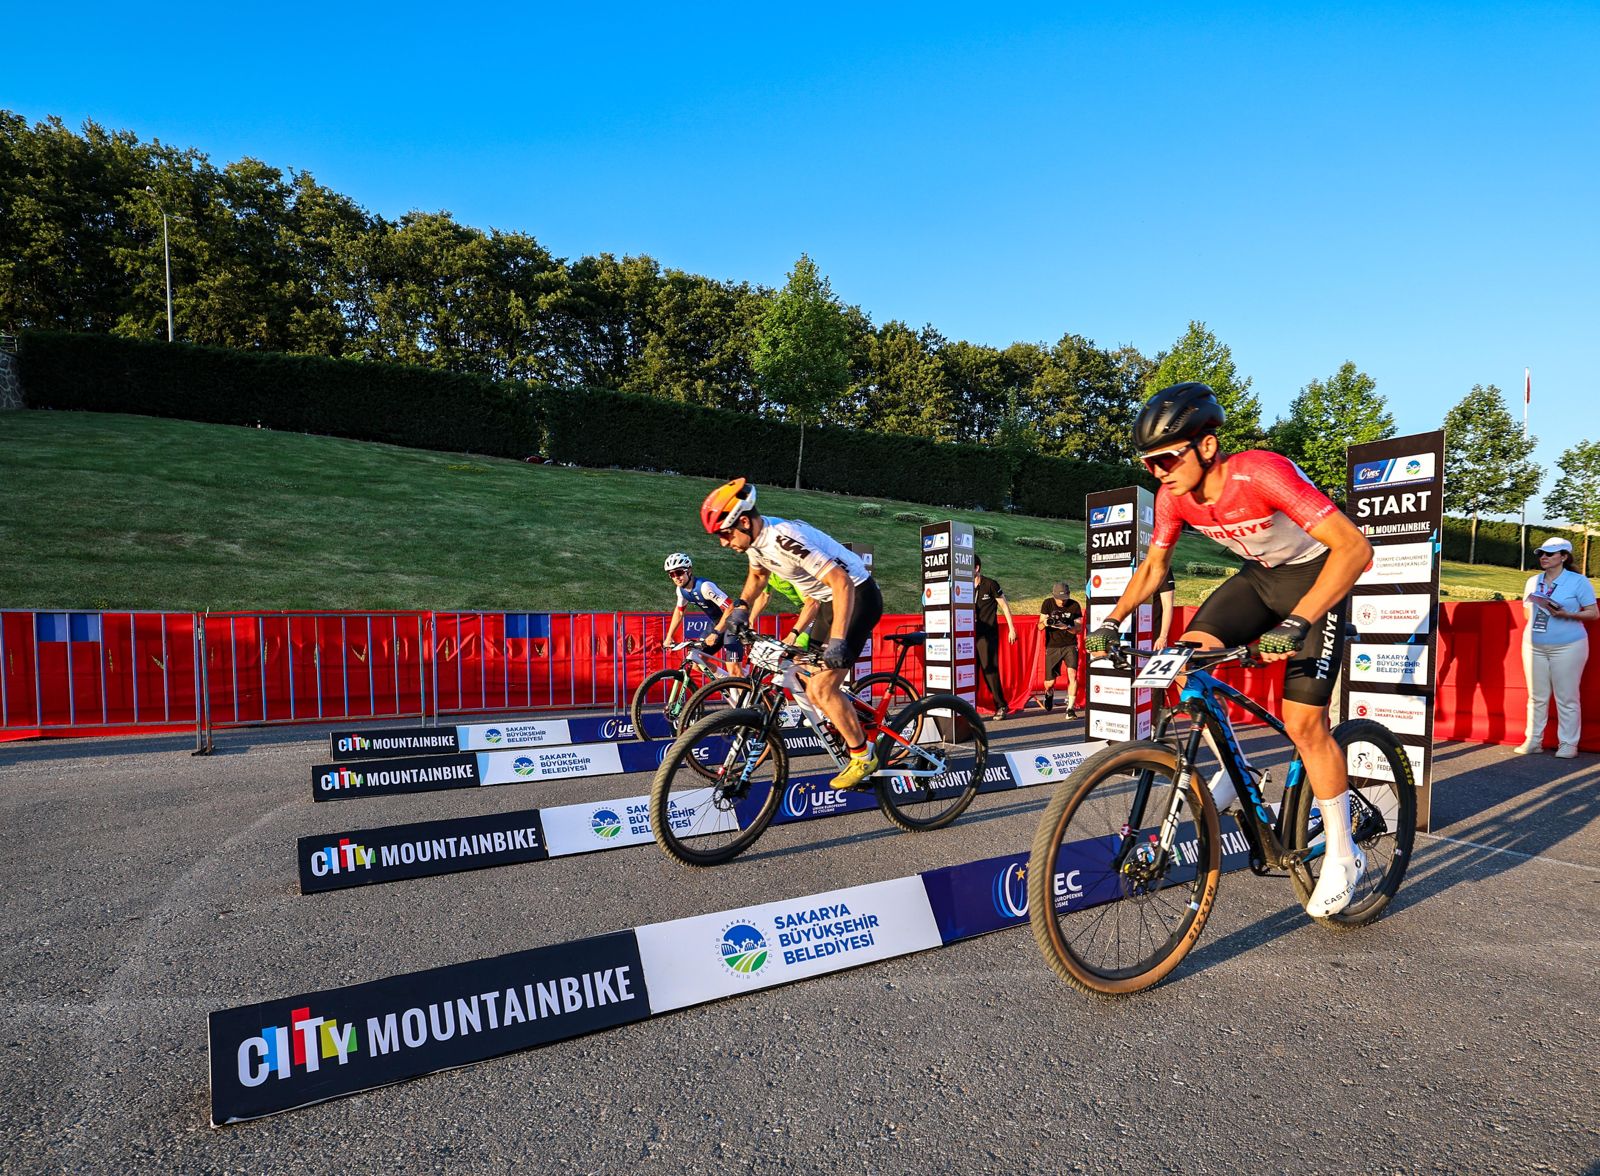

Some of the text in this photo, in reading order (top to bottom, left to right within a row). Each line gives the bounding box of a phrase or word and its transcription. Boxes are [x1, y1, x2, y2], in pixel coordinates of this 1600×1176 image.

[1356, 490, 1432, 517] START
[1202, 519, 1274, 539] ÜRKİYE
[1376, 521, 1431, 534] MOUNTAINBIKE
[1092, 530, 1131, 548] START
[924, 553, 949, 568] START
[955, 552, 973, 566] START
[1315, 611, 1338, 680] TÜRKİYE
[1145, 660, 1175, 675] 24
[1376, 660, 1420, 668] BÜYÜKŞEHİR
[1376, 666, 1416, 674] BELEDİYESİ
[618, 724, 634, 733] UE
[372, 735, 455, 750] MOUNTAINBIKE
[507, 735, 544, 743] BELEDİYESİ
[539, 752, 577, 762] SAKARYA
[691, 747, 709, 757] EC
[1052, 751, 1082, 760] SAKARYA
[540, 757, 591, 768] BÜYÜKŞEHİR
[542, 764, 588, 775] BELEDİYESİ
[367, 764, 474, 787] MOUNTAINBIKE
[811, 789, 847, 806] UEC
[628, 807, 696, 825] BÜYŞEHİR
[631, 817, 692, 835] BELYESİ
[310, 827, 539, 878] CITY MOUNTAINBIKE
[1054, 870, 1083, 896] EC
[774, 903, 851, 929] SAKARYA
[1188, 885, 1214, 941] MAXXIS
[778, 913, 880, 947] BÜYÜKŞEHİR
[783, 930, 875, 965] BELEDİYESİ
[238, 965, 635, 1088] CITY MOUNTAINBIKE
